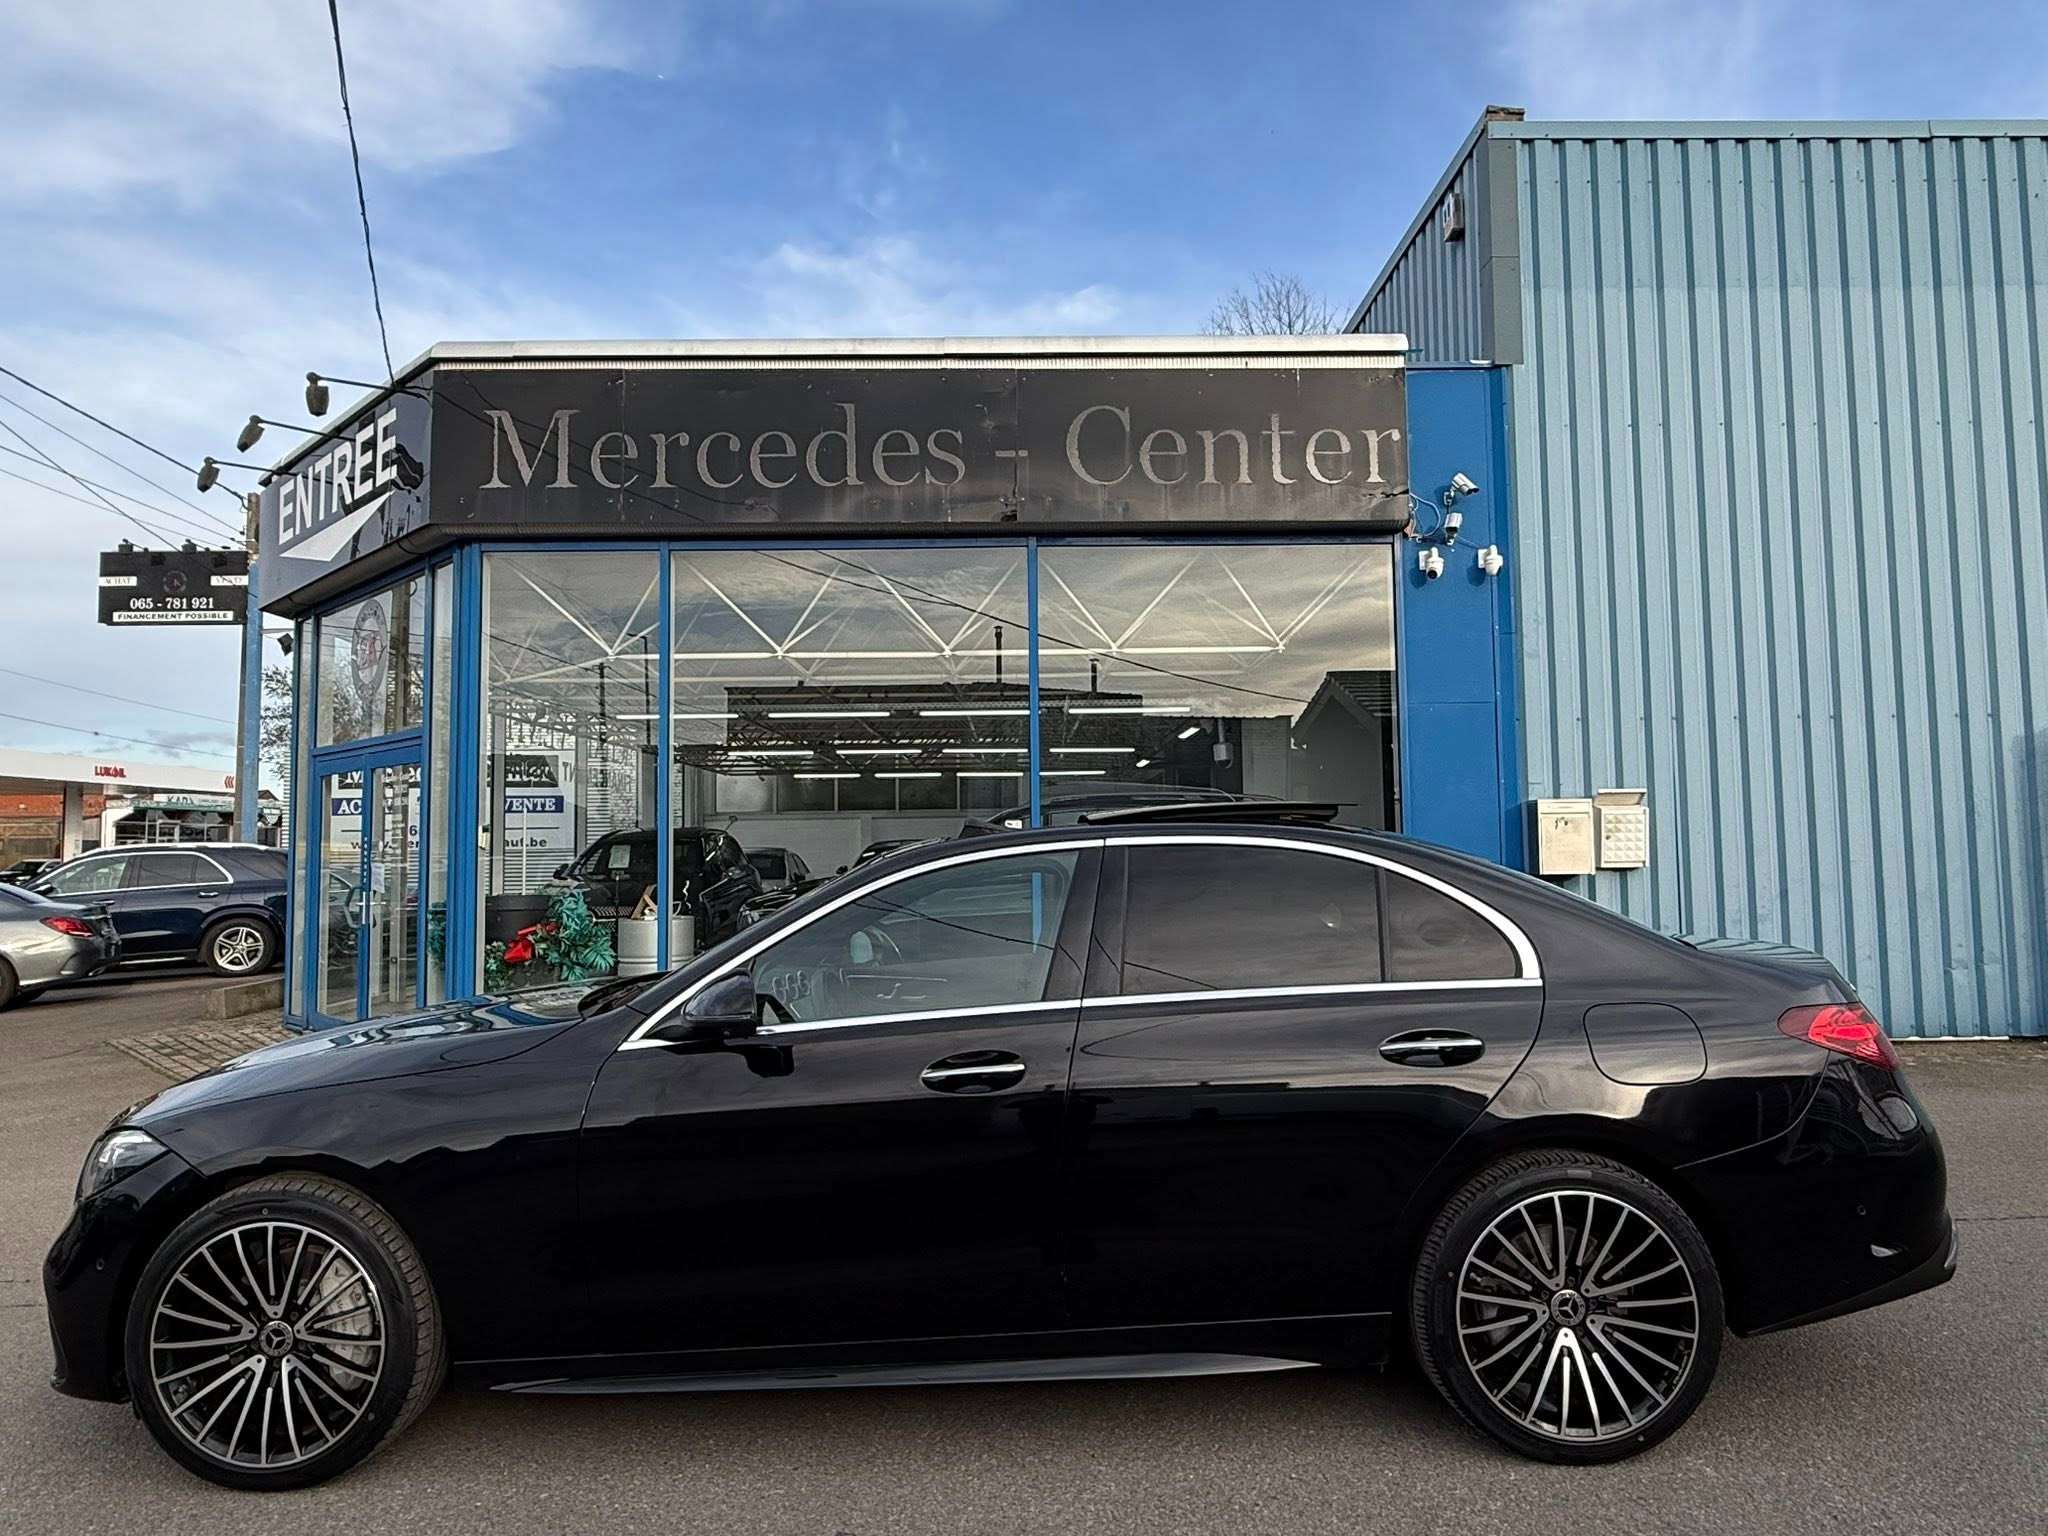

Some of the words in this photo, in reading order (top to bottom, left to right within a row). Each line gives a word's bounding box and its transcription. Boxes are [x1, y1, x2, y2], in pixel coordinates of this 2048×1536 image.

[480, 401, 967, 490] Mercedes
[1065, 404, 1401, 486] Center
[278, 407, 398, 545] ENTREE
[117, 612, 182, 621] FINANCEMENT
[185, 611, 229, 620] POSSIBLE
[130, 597, 153, 610] 065
[166, 597, 187, 610] 781
[191, 597, 214, 609] 921
